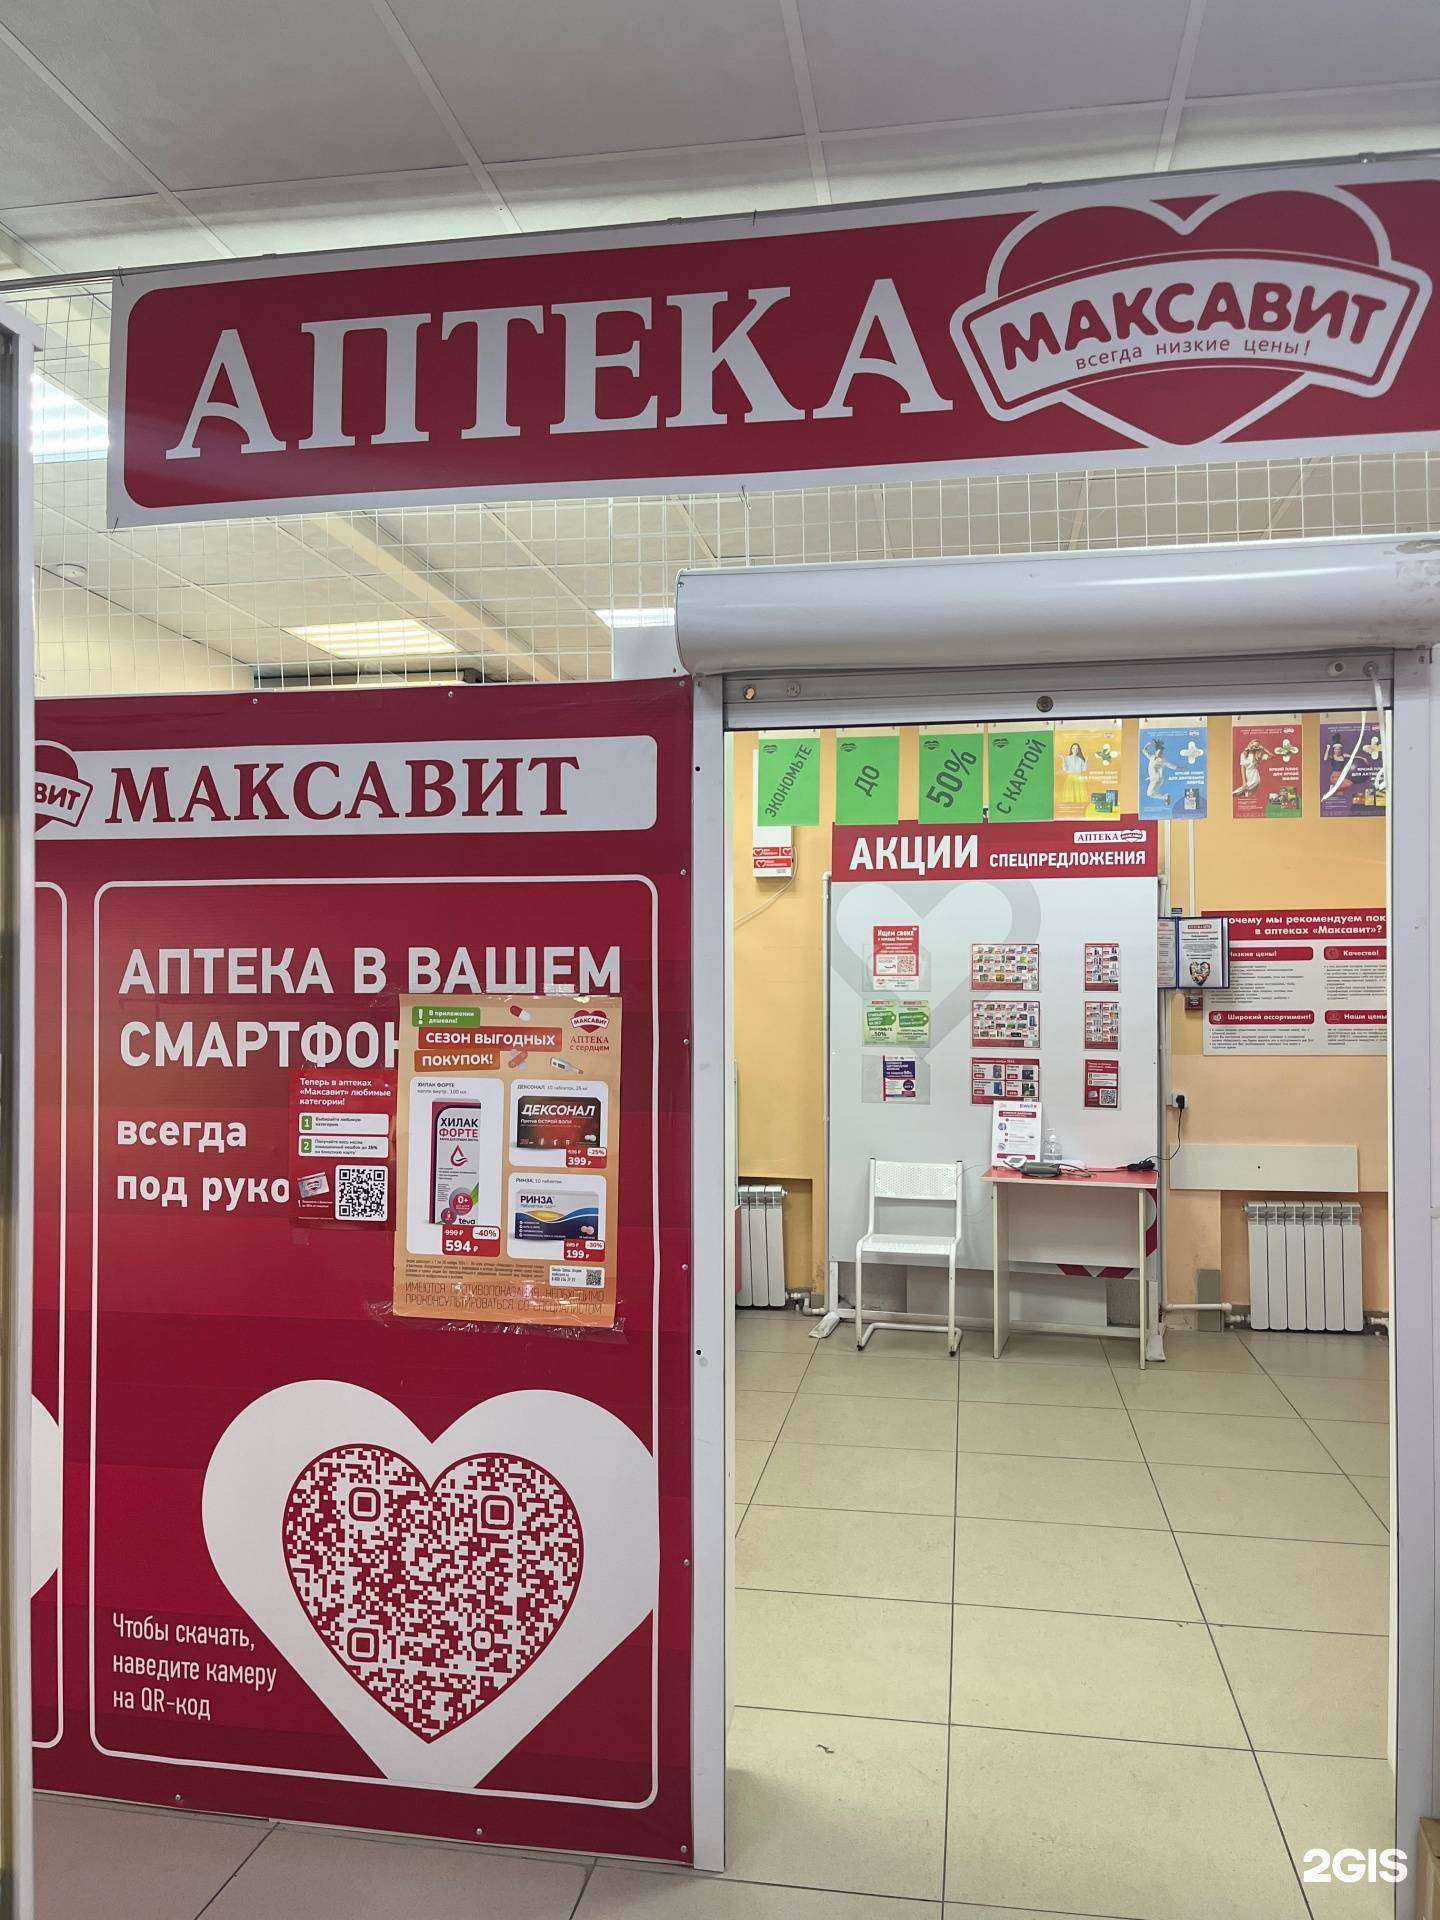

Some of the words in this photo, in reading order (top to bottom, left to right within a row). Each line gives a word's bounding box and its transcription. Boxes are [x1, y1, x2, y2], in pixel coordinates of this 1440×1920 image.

[999, 282, 1387, 370] МАКСАВИТ
[1075, 344, 1142, 371] всегда
[1156, 336, 1231, 356] низкие
[1244, 338, 1310, 358] цены!
[165, 278, 953, 460] АПТЕКА
[1002, 738, 1047, 802] КАРТОЙ
[764, 743, 813, 818] ЭКОНОМЬТЕ
[853, 763, 881, 797] ДО
[926, 748, 977, 808] 50%
[35, 782, 80, 810] ВИТ
[105, 756, 580, 824] МАКСАВИТ
[996, 802, 1012, 815] С
[1077, 833, 1119, 842] АПТЕКА
[849, 835, 979, 875] АКЦИИ
[989, 851, 1147, 869] СПЕЦПРЕДЛОЖЕНИЯ
[1286, 915, 1362, 926] рекомендуем
[1365, 914, 1387, 923] пок
[1312, 924, 1383, 935] «Максавит»?
[1343, 949, 1379, 957] Качество!
[118, 947, 335, 994] АПТЕКА
[354, 947, 387, 994] В
[408, 946, 621, 995] ВАШЕМ
[572, 1014, 608, 1027] МАКСАВИТ
[1227, 1012, 1262, 1021] Широкий
[120, 1022, 400, 1068] СМАРТФОН
[425, 1032, 471, 1045] СЕЗОН
[474, 1033, 556, 1046] ВЫГОДНЫХ
[569, 1035, 609, 1045] АПТЕКА
[575, 1044, 610, 1053] сердцем
[422, 1053, 494, 1067] ПОКУПОК!
[299, 1077, 330, 1087] Теперь
[299, 1088, 349, 1097] «Максавит»
[350, 1088, 391, 1097] любимые
[299, 1098, 345, 1106] категории!
[520, 1104, 596, 1117] ДЕКСОНАЛ
[304, 1118, 309, 1128] 1
[440, 1117, 479, 1128] ХИЛАК
[118, 1117, 247, 1155] всегда
[439, 1128, 478, 1138] ФОРТЕ
[303, 1141, 310, 1151] 2
[567, 1157, 587, 1166] 399
[117, 1174, 188, 1208] под
[202, 1174, 289, 1212] руко
[457, 1196, 468, 1204] 0+
[520, 1195, 553, 1205] РИНЗА
[474, 1229, 497, 1238] -40%
[445, 1239, 471, 1252] 594
[566, 1249, 584, 1259] 199
[113, 1612, 169, 1642] Чтобы
[175, 1624, 255, 1651] скачать,
[113, 1654, 199, 1682] наведите
[206, 1663, 277, 1692] камеру
[113, 1690, 135, 1710] на
[140, 1687, 211, 1721] QR-код
